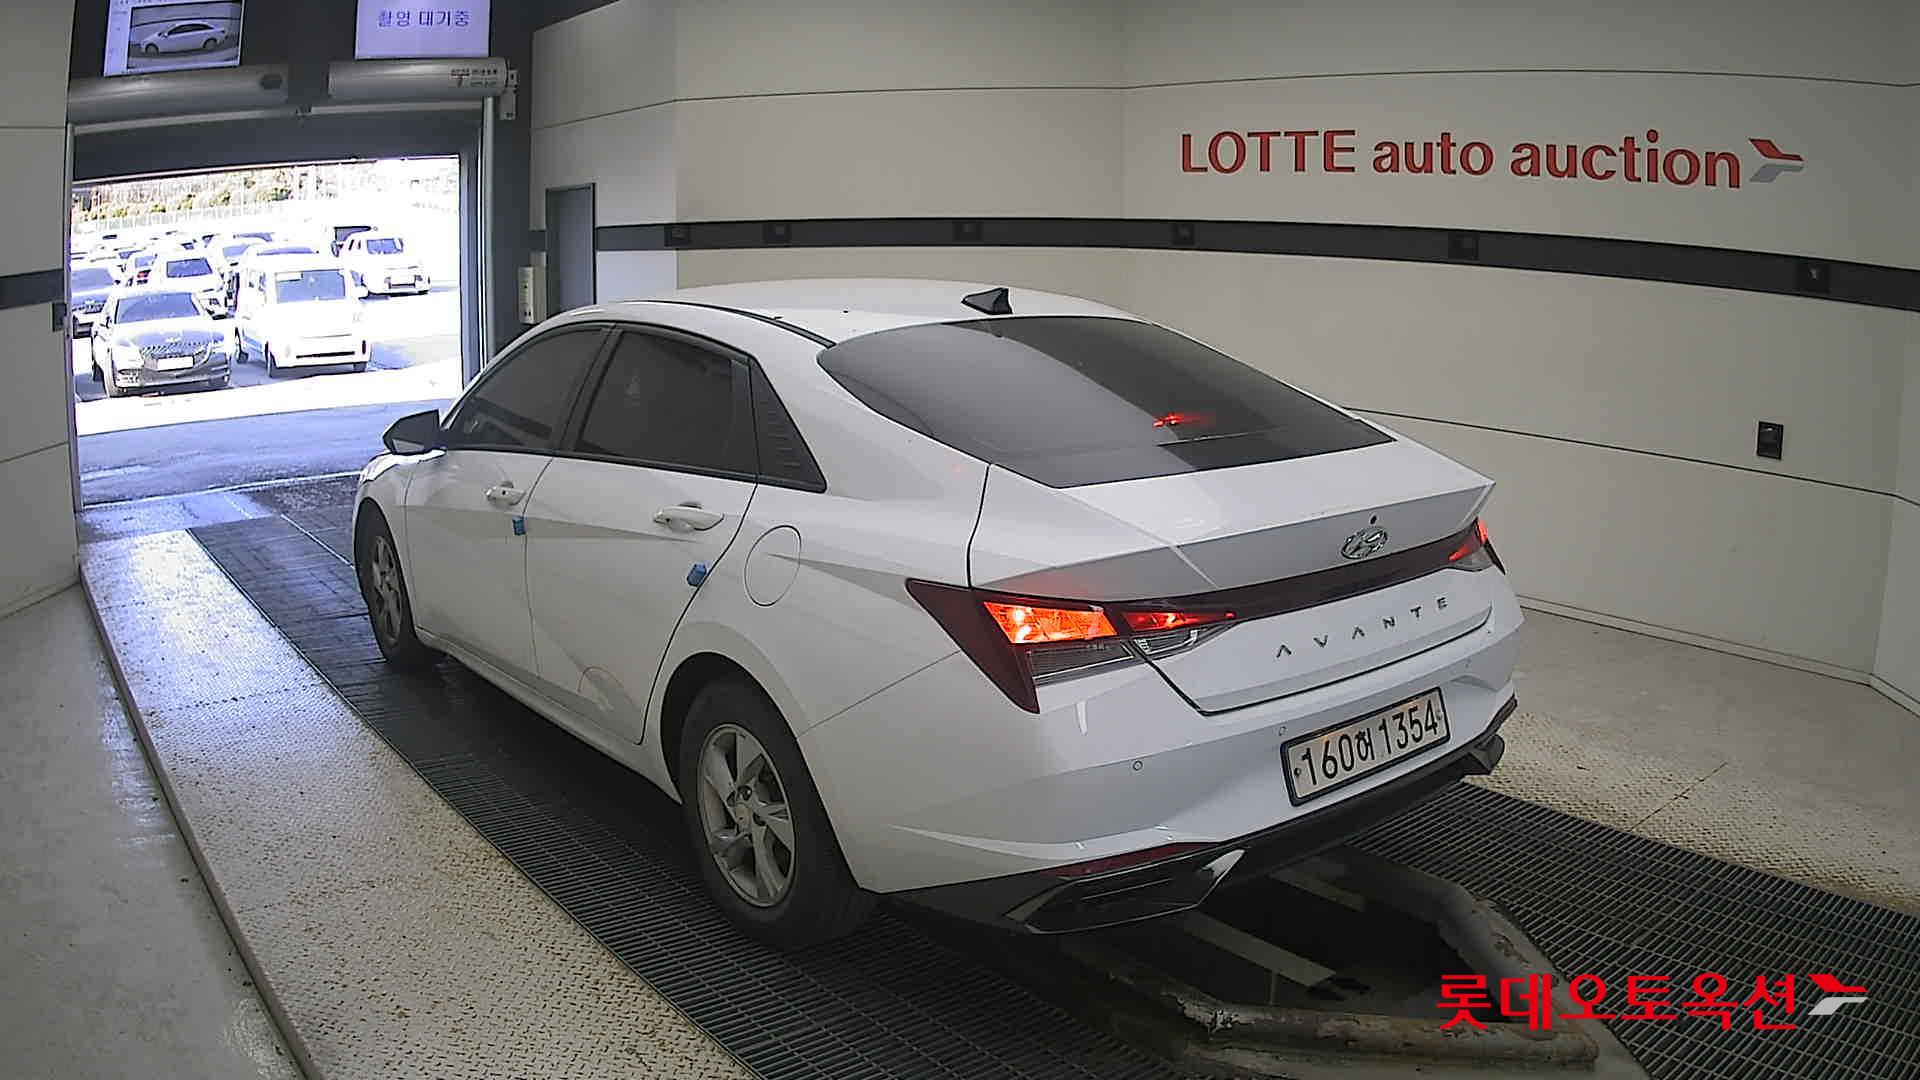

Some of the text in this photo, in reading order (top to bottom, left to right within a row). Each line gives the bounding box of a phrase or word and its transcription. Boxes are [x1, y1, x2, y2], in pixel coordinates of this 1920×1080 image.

[419, 9, 471, 27] 대기중
[1181, 129, 1742, 188] LOTTE auto auction
[1275, 596, 1449, 659] AVANTE
[1301, 699, 1438, 786] 160허 1354
